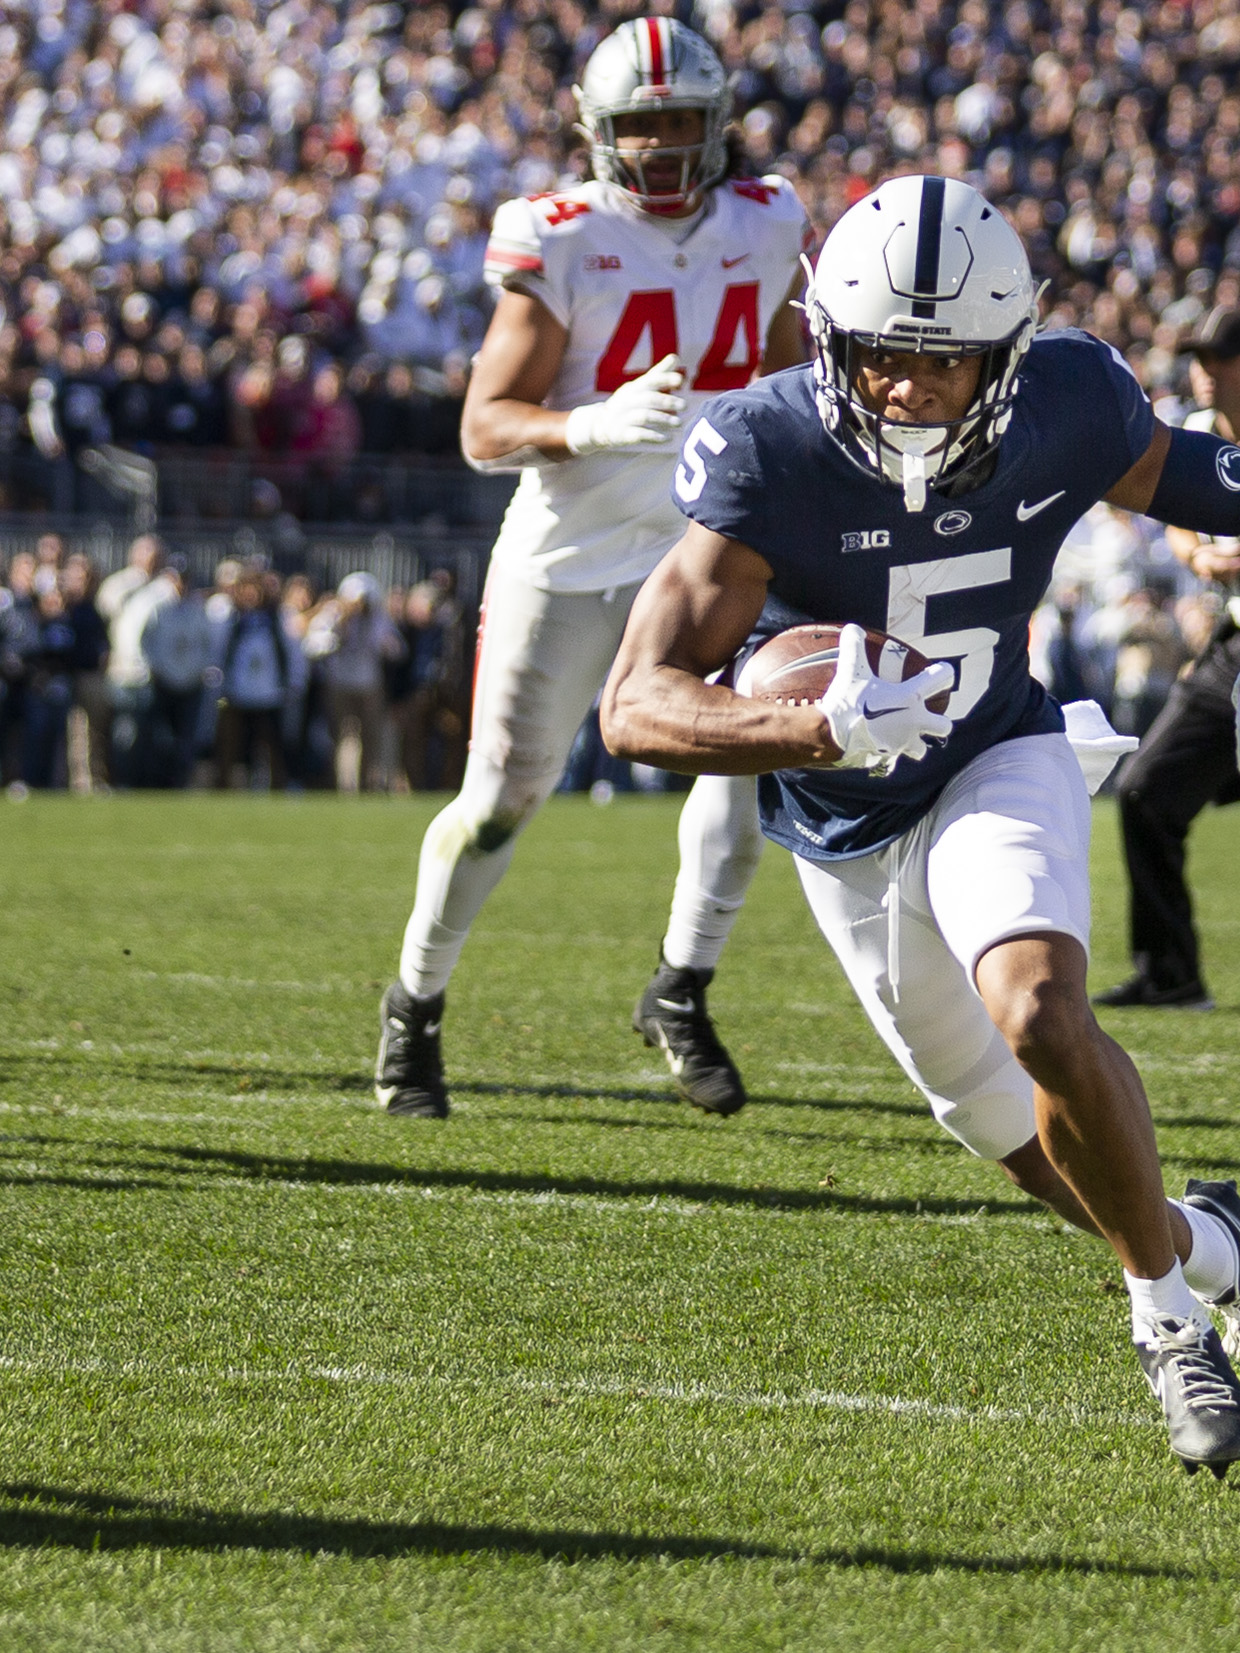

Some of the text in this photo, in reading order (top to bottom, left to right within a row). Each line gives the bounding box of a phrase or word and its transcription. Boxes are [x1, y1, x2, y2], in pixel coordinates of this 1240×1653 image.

[596, 279, 761, 393] 44
[893, 323, 952, 336] PENN STATE
[675, 416, 728, 502] 5
[886, 547, 1012, 721] 5
